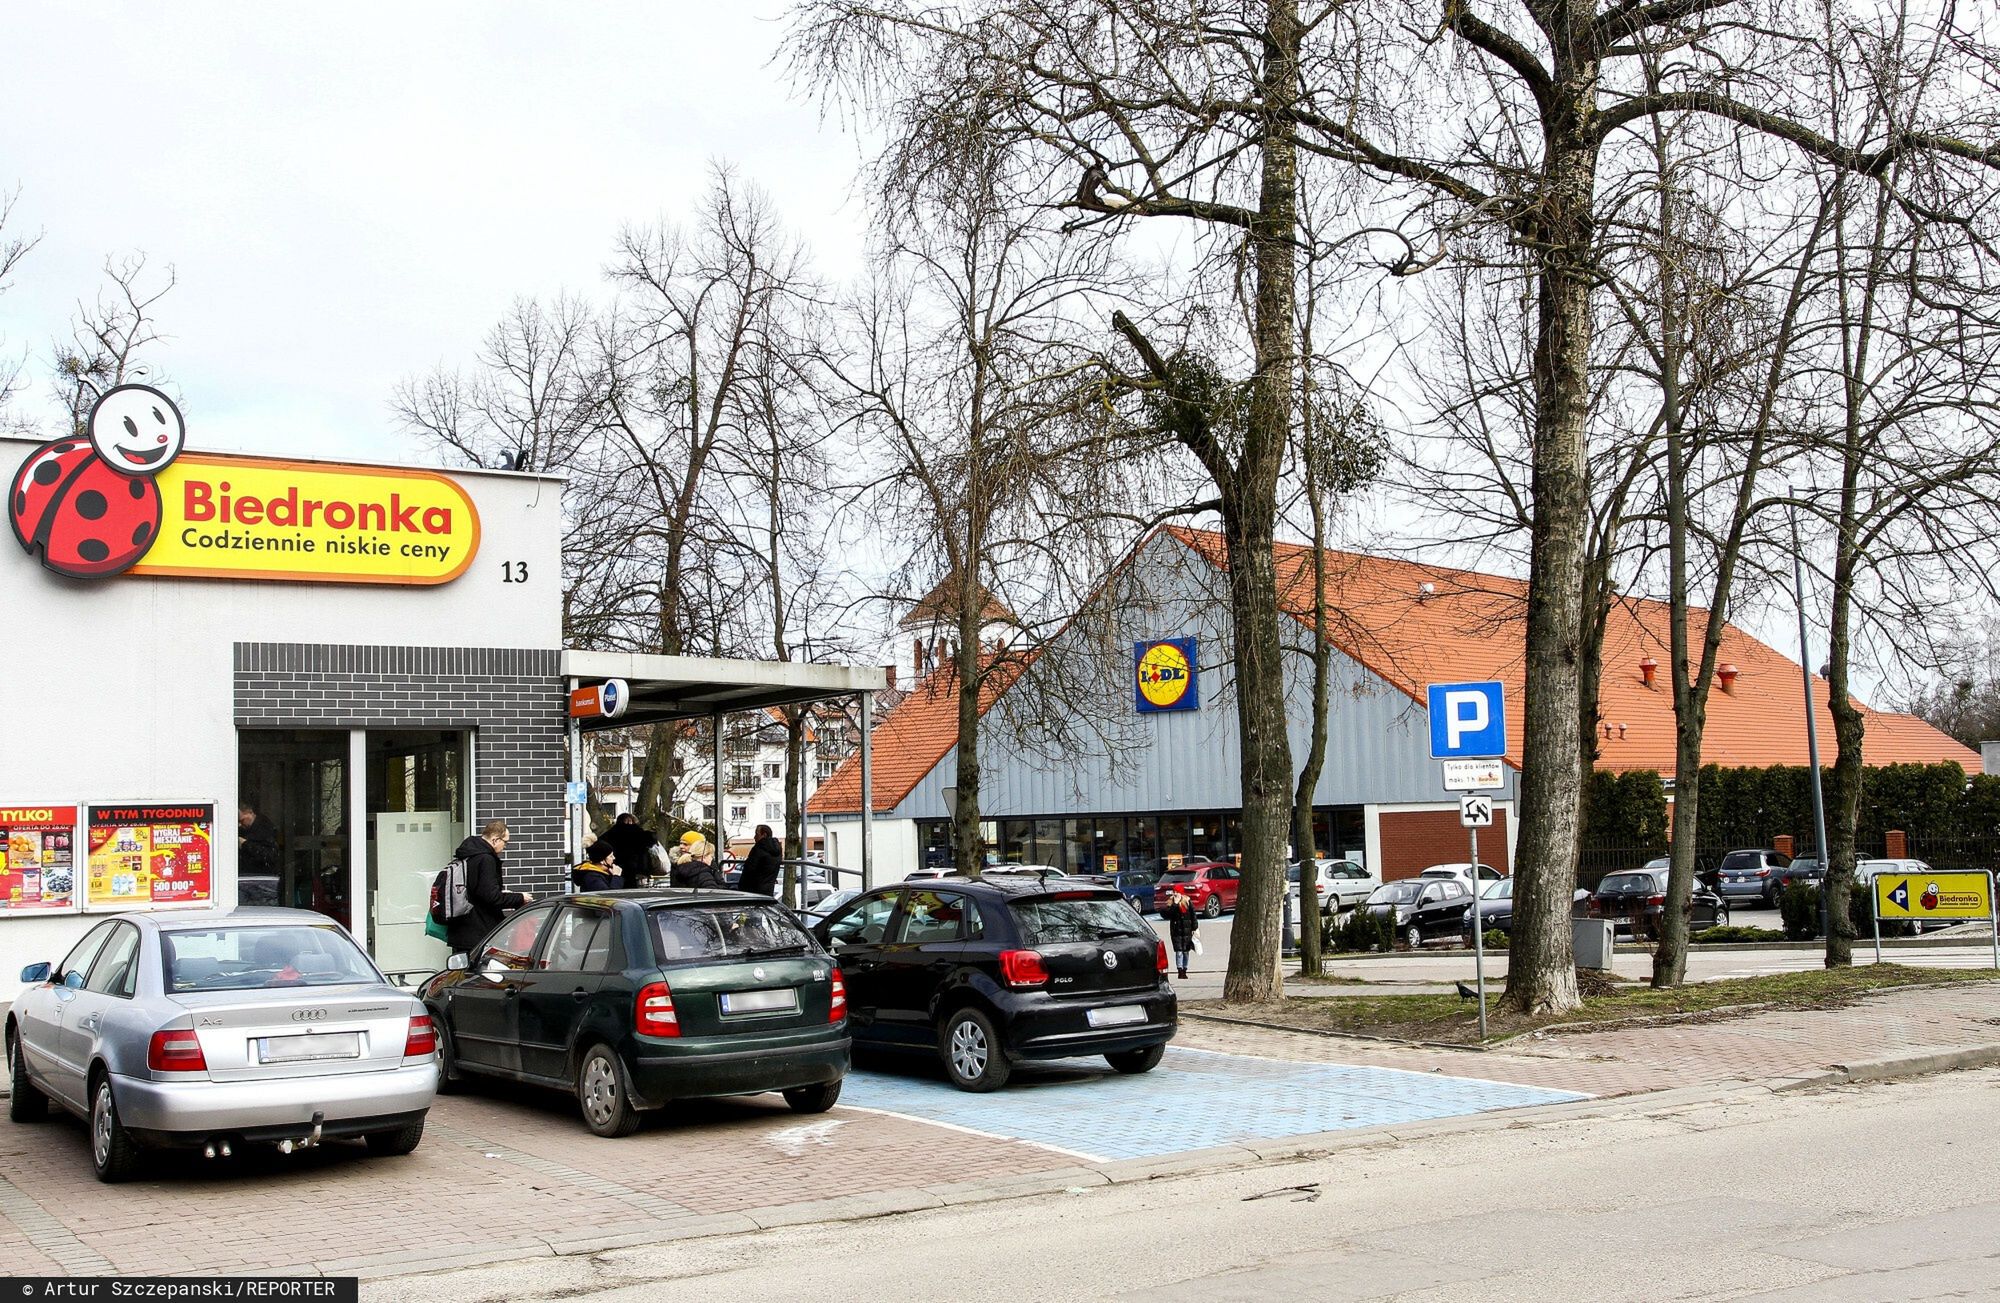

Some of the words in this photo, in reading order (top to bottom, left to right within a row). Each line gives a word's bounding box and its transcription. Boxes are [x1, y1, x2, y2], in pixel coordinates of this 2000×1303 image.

[184, 480, 451, 535] Biedronka
[181, 528, 316, 553] Codziennie
[326, 534, 391, 556] niskie
[400, 543, 450, 562] ceny
[501, 560, 529, 584] 13
[1445, 690, 1490, 749] P
[1, 809, 53, 822] TYLKO!
[97, 810, 111, 820] W
[113, 810, 139, 820] TYM
[142, 808, 205, 820] TYGODNIU
[153, 881, 171, 892] 500
[171, 880, 189, 890] 000
[1896, 890, 1906, 903] P
